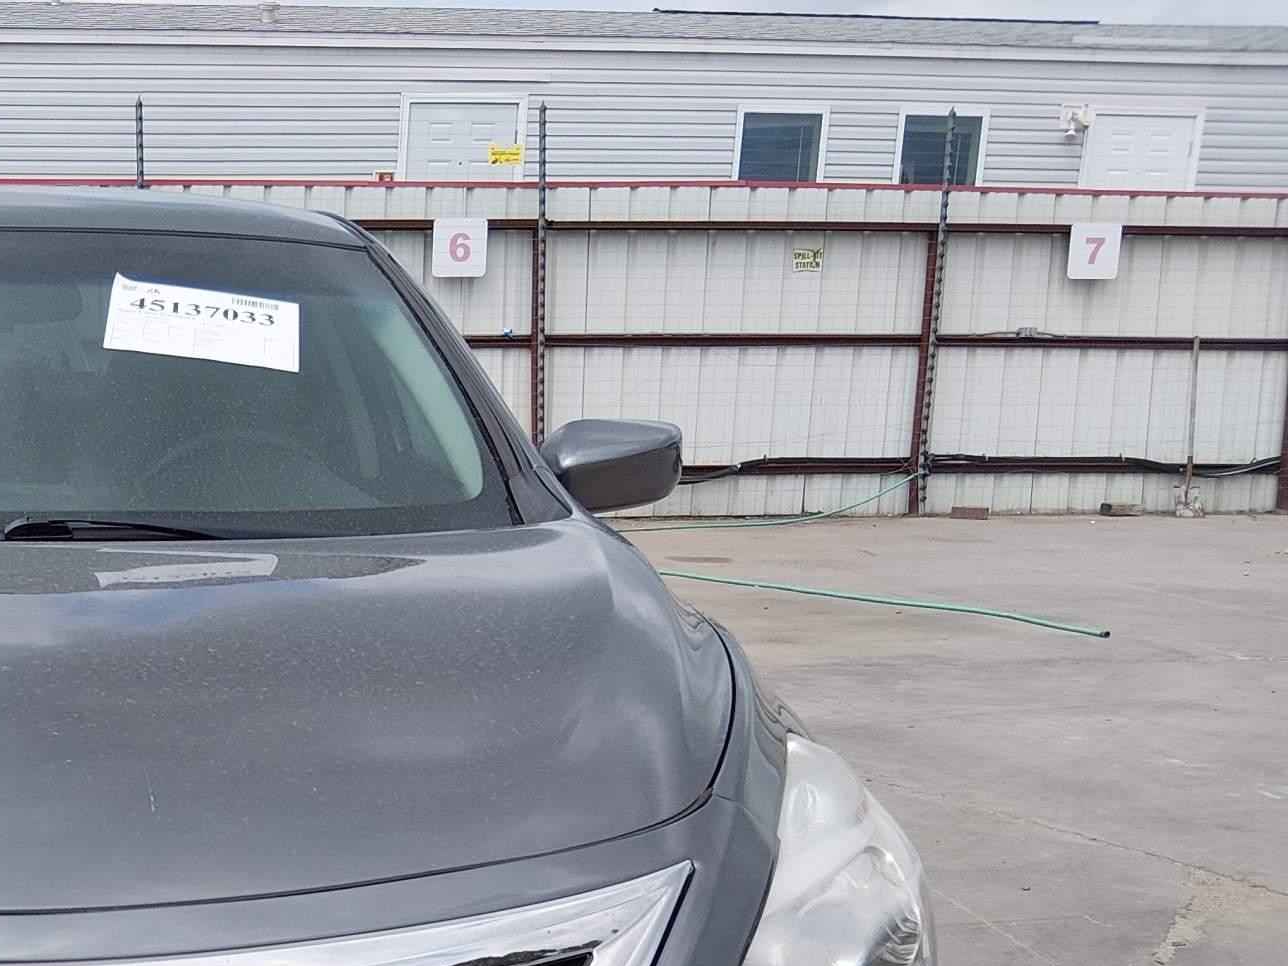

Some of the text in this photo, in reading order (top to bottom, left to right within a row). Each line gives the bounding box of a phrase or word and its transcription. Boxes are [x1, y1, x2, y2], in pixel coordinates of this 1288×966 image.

[449, 232, 471, 263] 6
[1085, 236, 1106, 265] 7
[130, 297, 275, 327] 45137033
